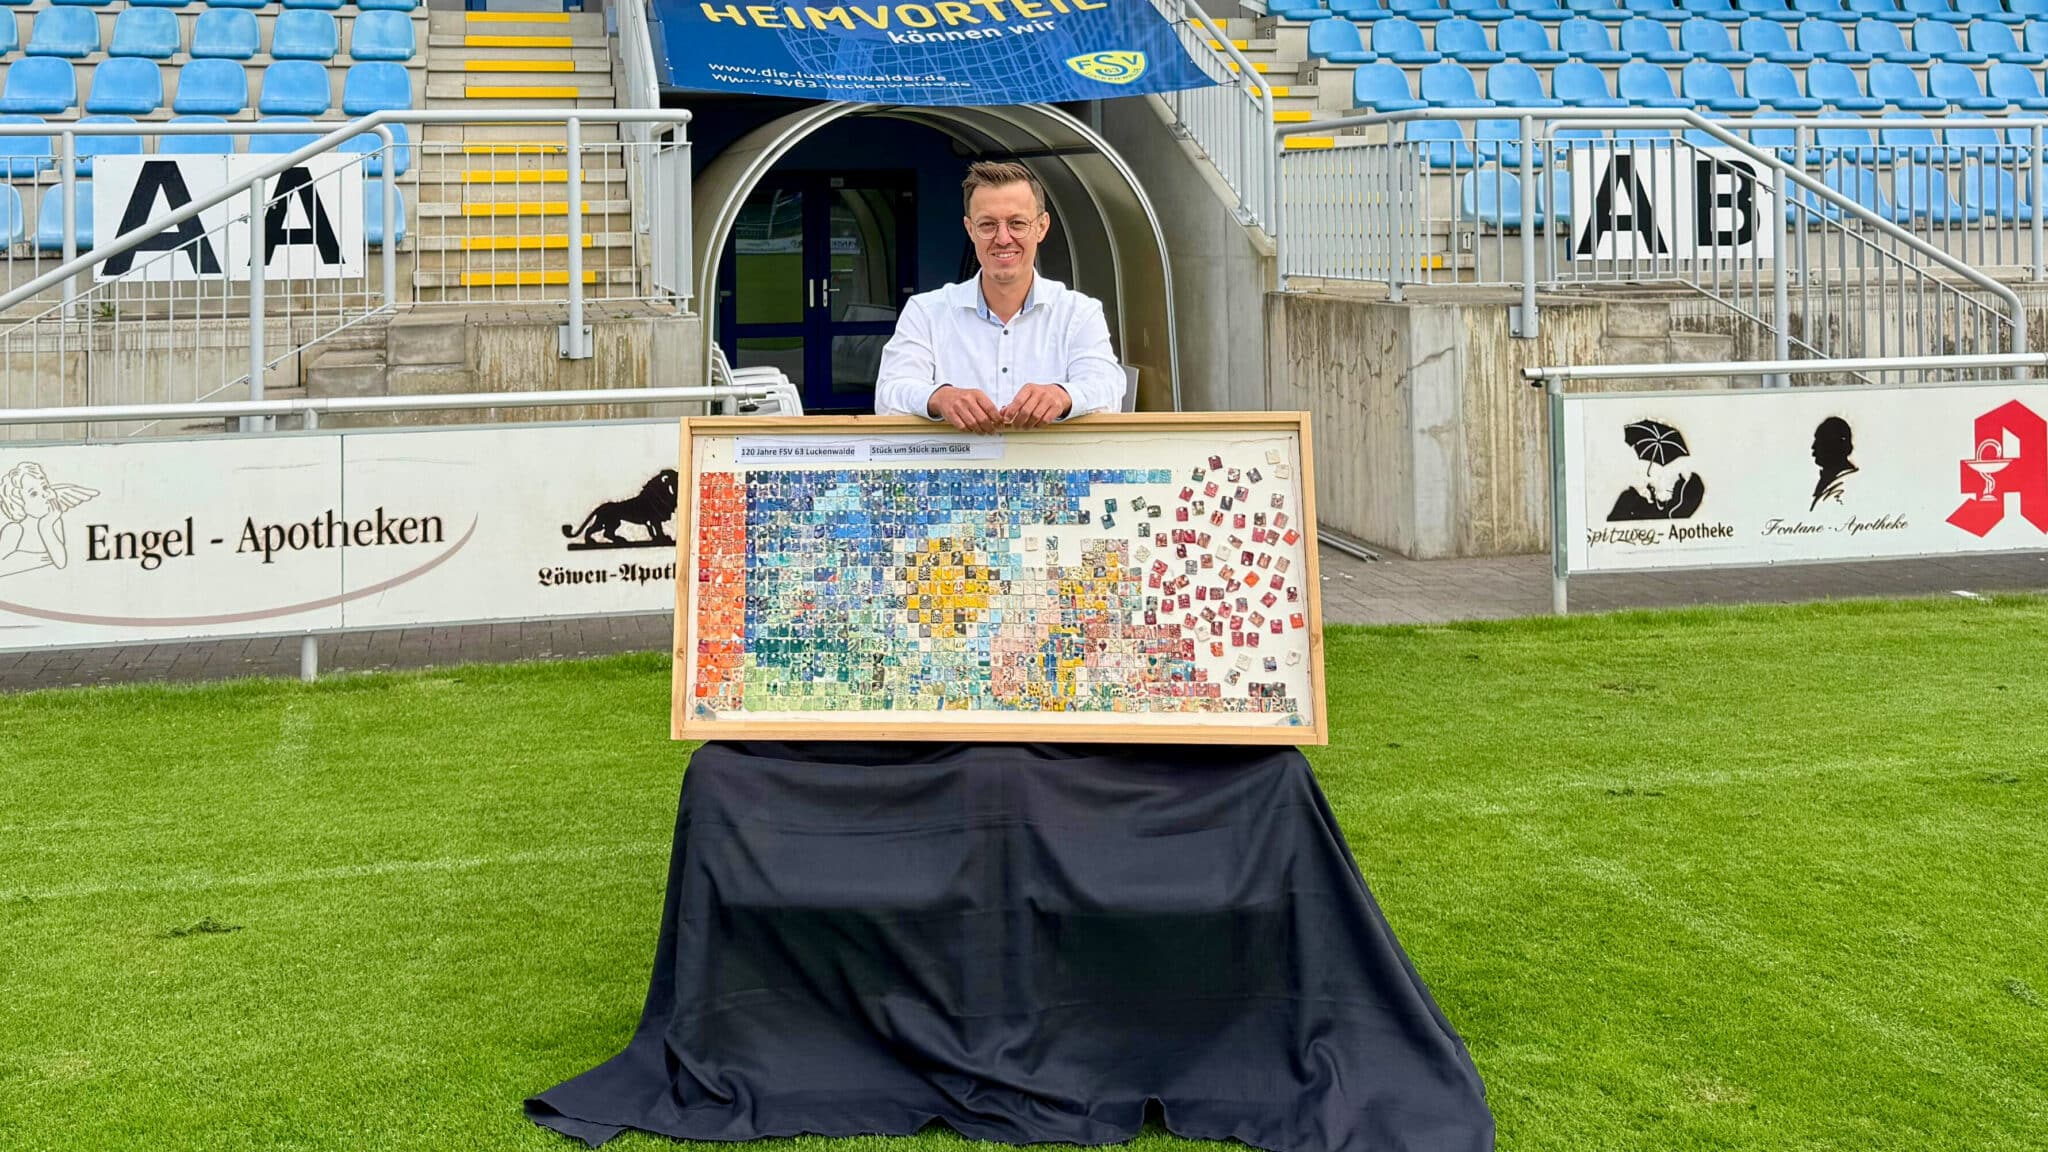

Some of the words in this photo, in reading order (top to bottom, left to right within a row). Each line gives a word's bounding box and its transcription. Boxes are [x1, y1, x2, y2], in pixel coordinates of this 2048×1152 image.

[887, 30, 1002, 44] können
[1008, 19, 1055, 36] wir
[708, 63, 947, 82] www.die-luckenwalder.de
[1076, 54, 1138, 77] FSV
[741, 448, 755, 456] 120
[756, 448, 777, 456] Jahre
[779, 448, 793, 456] FSV
[794, 448, 804, 456] 63
[806, 447, 855, 456] Luckenwalde
[871, 445, 893, 454] Stück
[895, 446, 907, 454] um
[908, 444, 929, 454] Stück
[931, 445, 947, 453] zum
[949, 442, 970, 453] Glück
[1668, 522, 1734, 543] Apotheke
[1761, 518, 1824, 536] Fontane
[1834, 513, 1909, 536] Apotheke
[86, 517, 194, 571] Engel
[236, 506, 445, 564] Apotheken
